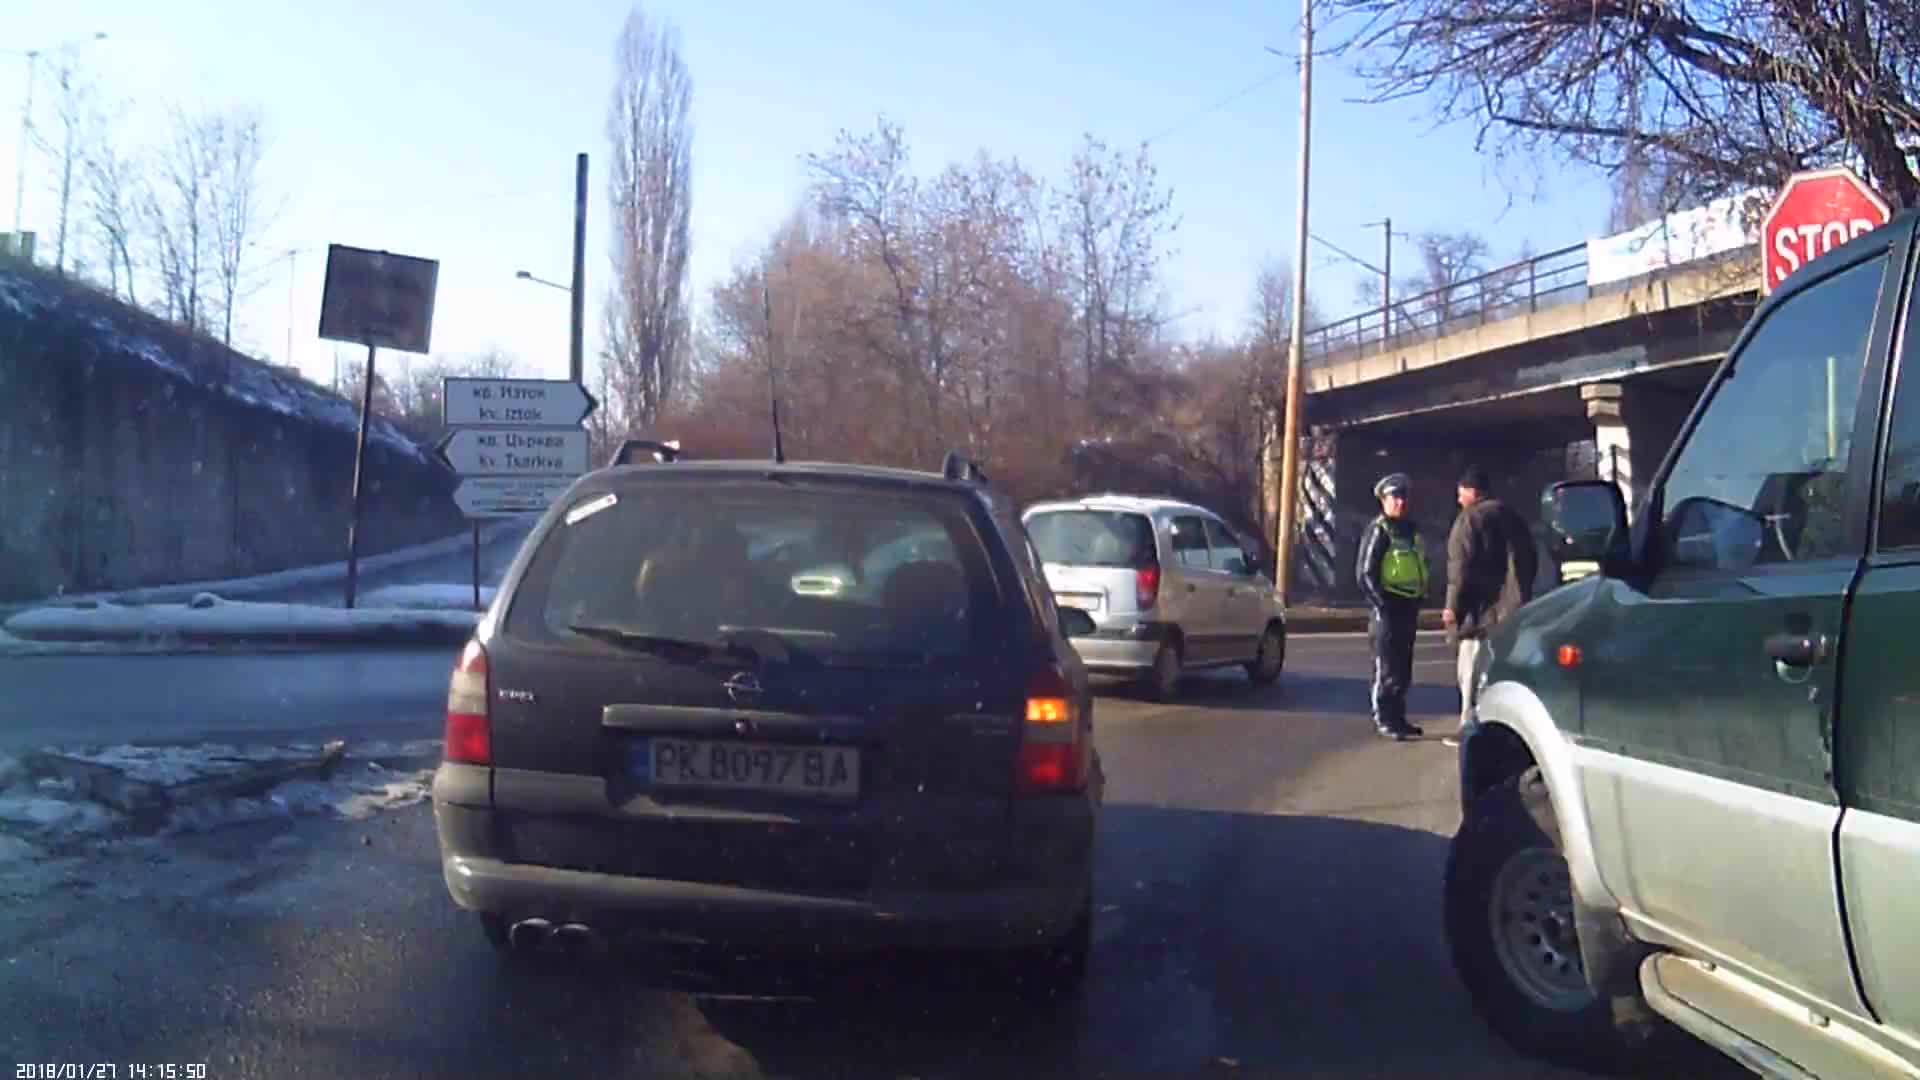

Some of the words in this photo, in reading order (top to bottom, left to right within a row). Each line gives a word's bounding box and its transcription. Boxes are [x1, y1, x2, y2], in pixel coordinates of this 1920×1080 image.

[500, 385, 545, 400] Изток
[505, 407, 543, 420] Iztok
[505, 433, 565, 449] Църква
[505, 453, 564, 469] Tsarkva
